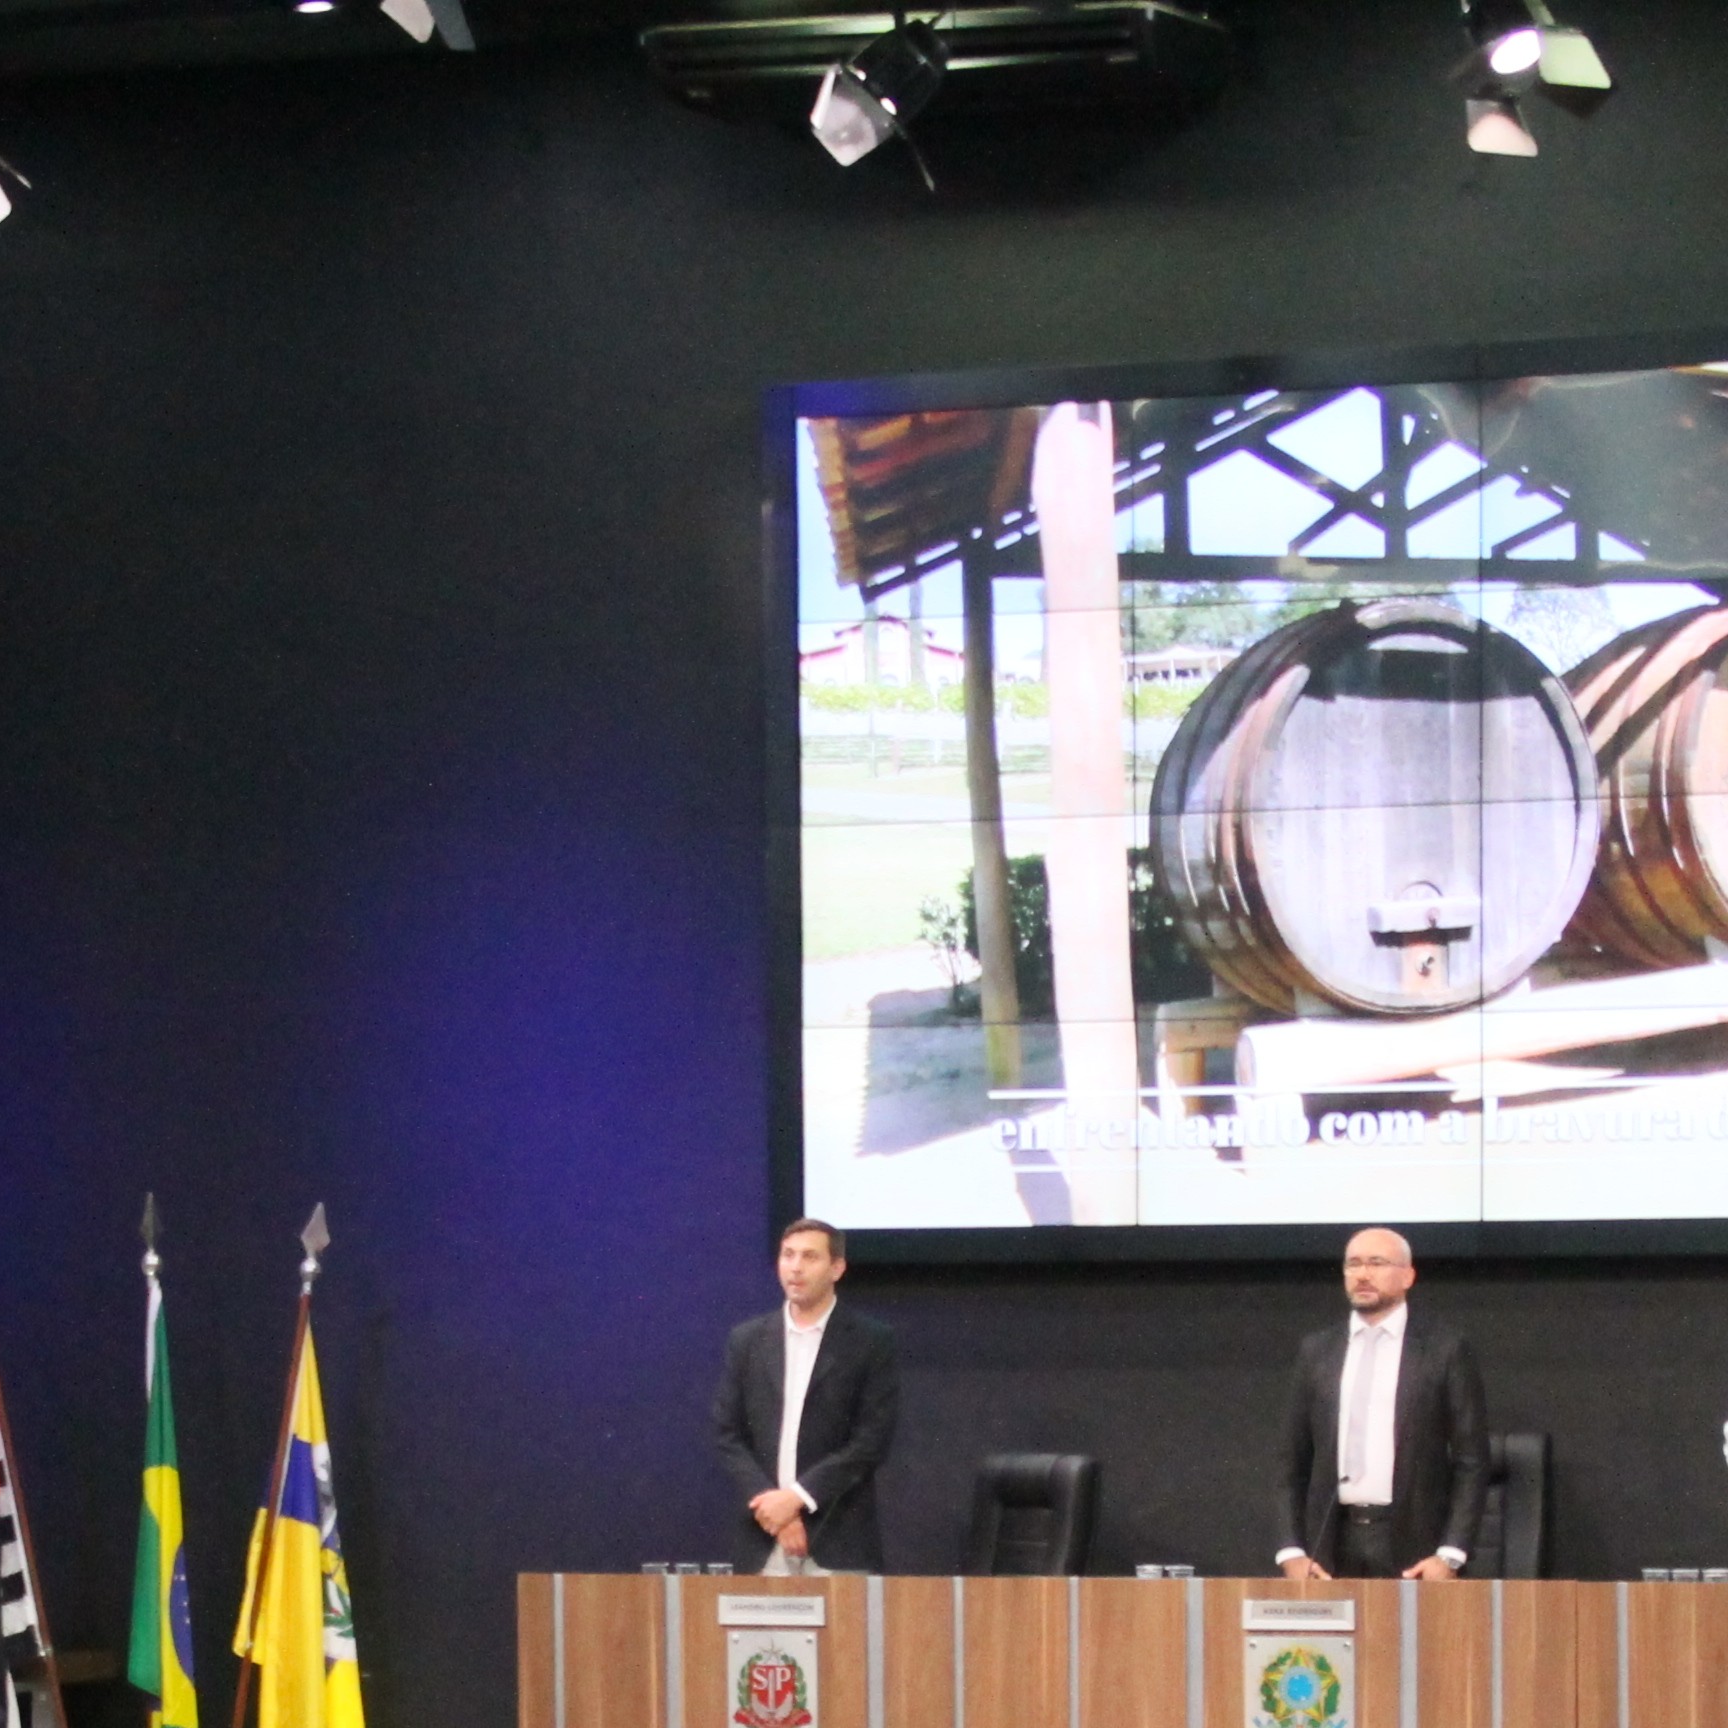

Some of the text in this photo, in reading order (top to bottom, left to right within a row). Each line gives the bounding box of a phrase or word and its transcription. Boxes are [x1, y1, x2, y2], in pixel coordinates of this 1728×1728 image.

[990, 1094, 1309, 1152] enfrentando
[1319, 1109, 1427, 1147] com
[1439, 1110, 1470, 1146] a
[1482, 1096, 1695, 1144] bravura
[752, 1666, 792, 1691] SP
